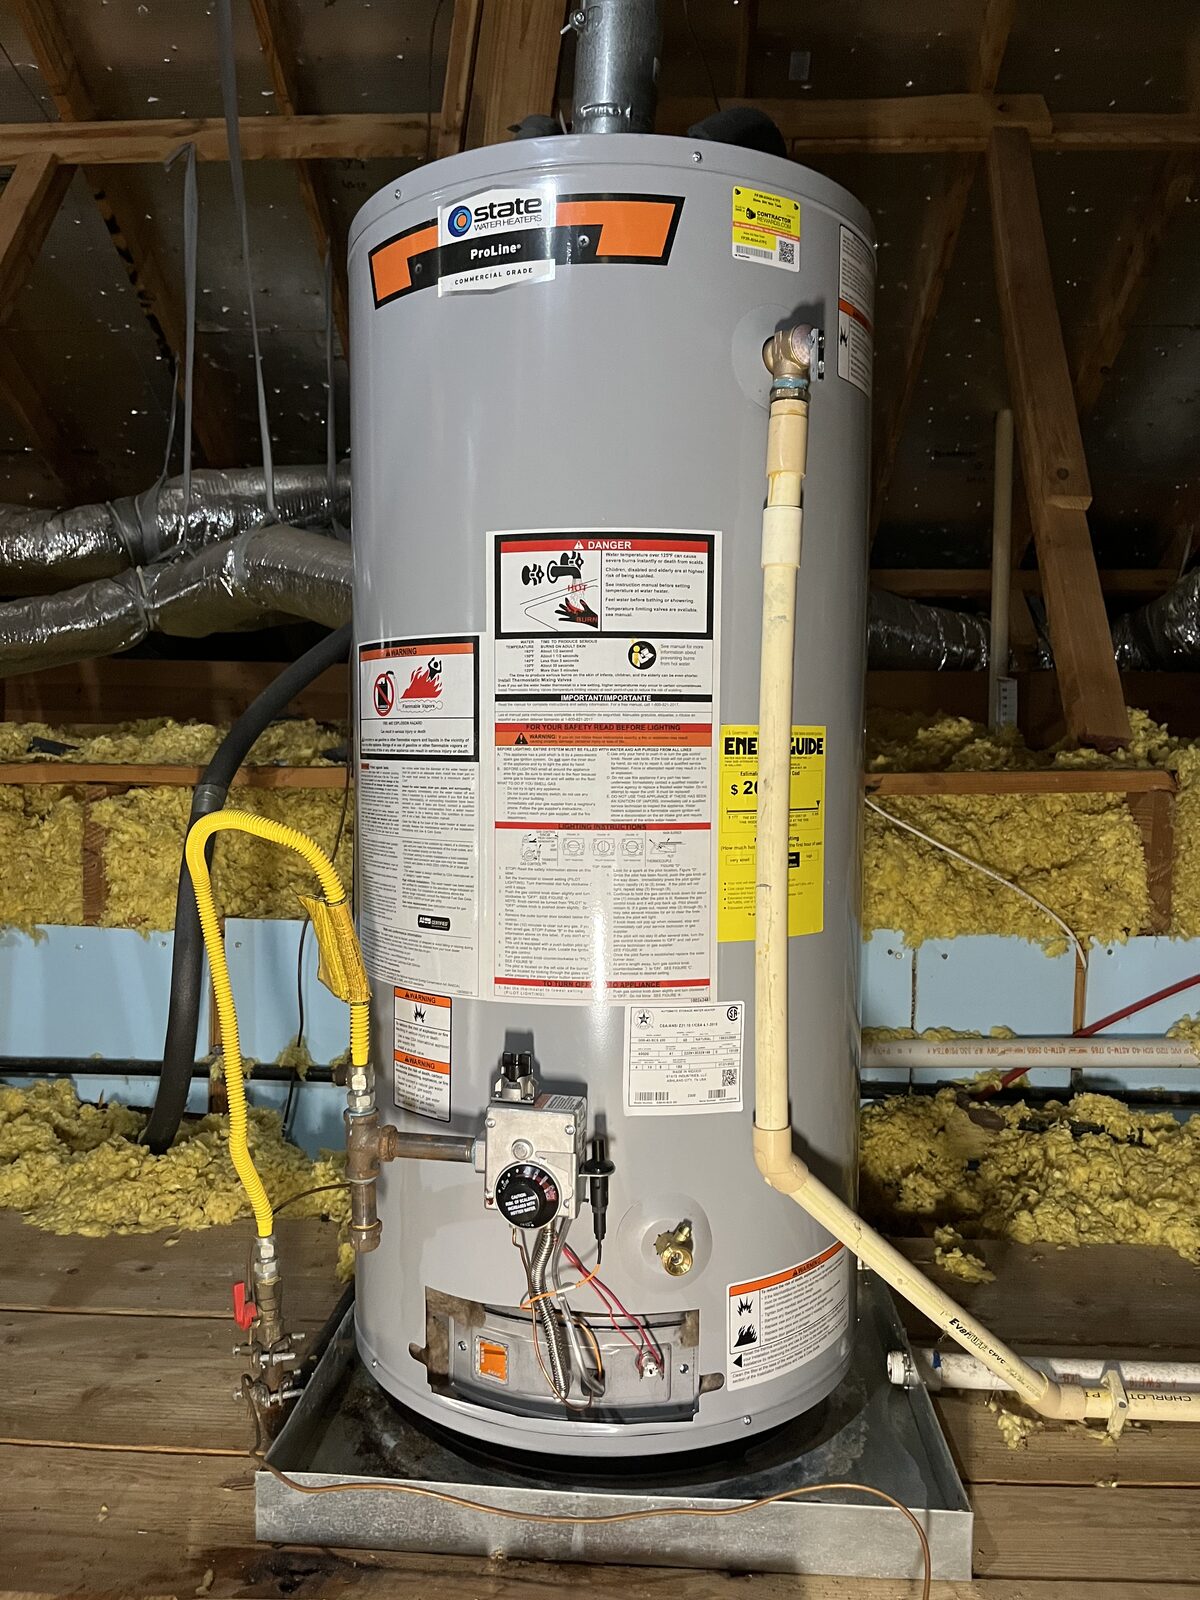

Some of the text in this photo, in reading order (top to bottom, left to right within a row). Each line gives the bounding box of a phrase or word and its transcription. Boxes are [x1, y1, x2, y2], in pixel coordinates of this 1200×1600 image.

[474, 198, 542, 223] state
[474, 215, 542, 231] WATER HEATERS
[757, 211, 791, 223] CONTRACTOR
[455, 272, 502, 284] COMMERCIAL
[588, 541, 631, 550] DANGER
[391, 648, 417, 656] WARNING
[724, 737, 757, 755] ENE
[731, 784, 738, 795] $
[410, 992, 436, 1003] WARNING
[409, 1057, 435, 1069] WARNING
[988, 1349, 1006, 1364] CPVC
